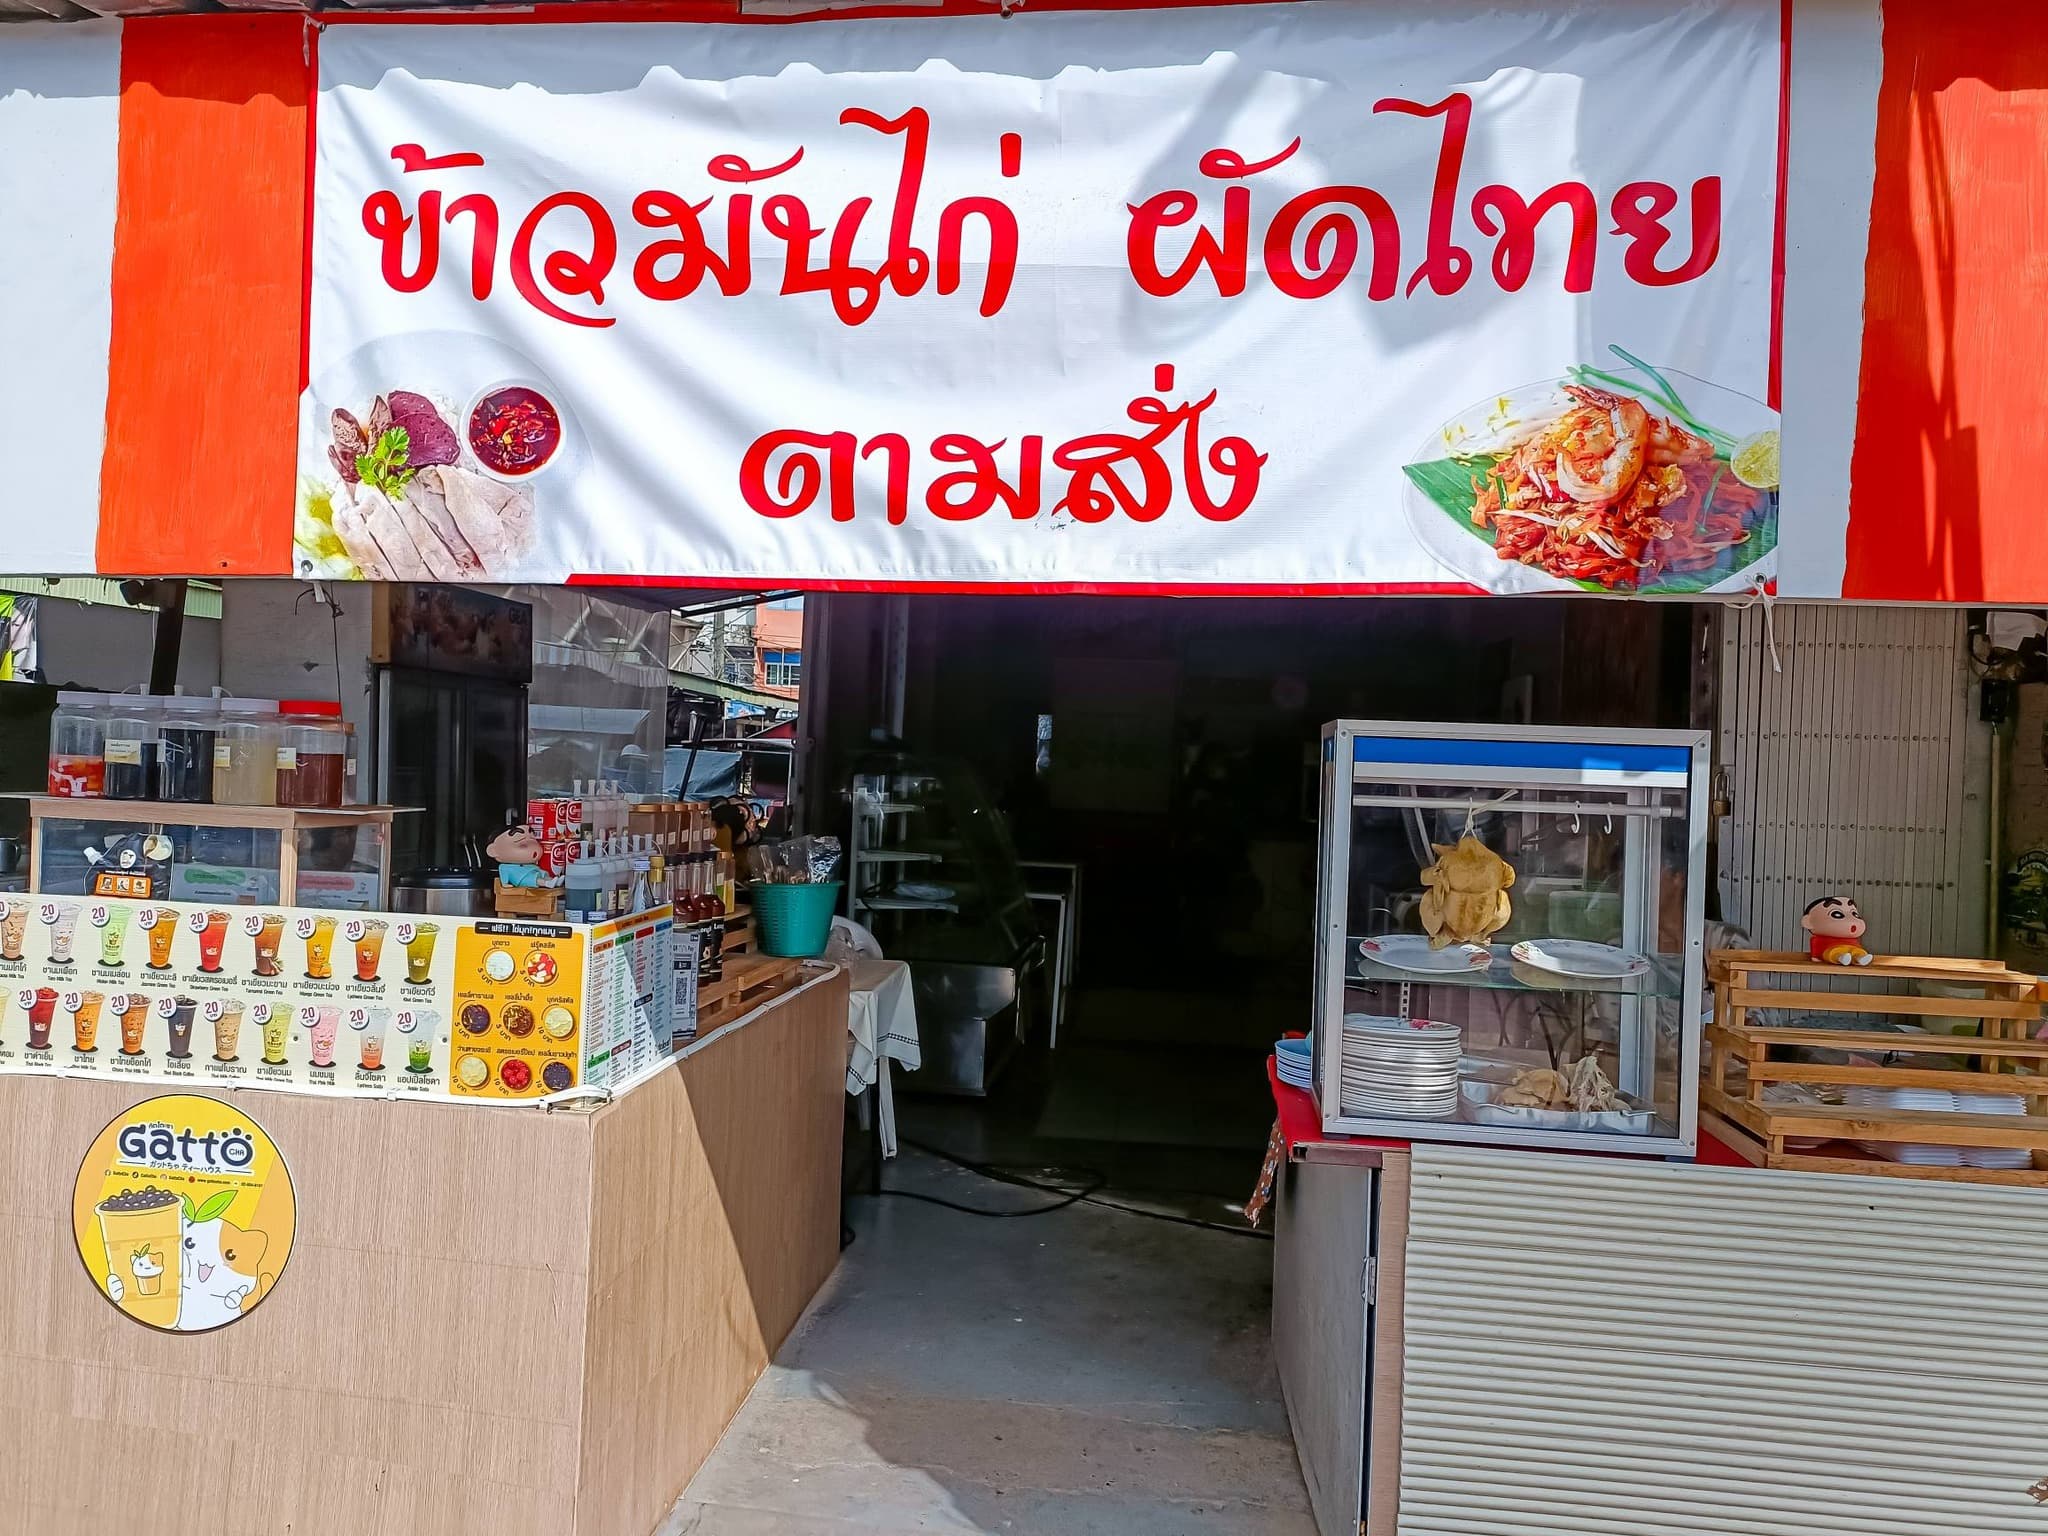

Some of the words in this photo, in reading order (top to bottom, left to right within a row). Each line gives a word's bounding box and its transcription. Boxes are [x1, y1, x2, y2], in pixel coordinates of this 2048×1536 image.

[362, 107, 1021, 328] ข้าวมันไก่
[1128, 94, 1720, 301] ผัดไทย
[740, 364, 1268, 525] ตามสั่ง
[41, 904, 55, 916] 20
[92, 907, 106, 919] 20
[140, 909, 154, 922] 20
[190, 912, 204, 925] 20
[245, 916, 259, 928] 20
[297, 918, 311, 931] 20
[347, 921, 360, 933] 20
[398, 923, 412, 936] 20
[19, 990, 33, 1002] 20
[65, 993, 79, 1005] 20
[111, 995, 125, 1008] 20
[159, 998, 172, 1011] 20
[205, 1001, 219, 1014] 20
[254, 1004, 268, 1017] 20
[301, 1007, 315, 1019] 20
[349, 1009, 364, 1022] 20
[398, 1012, 412, 1025] 20
[74, 1054, 95, 1063] ชาไทย
